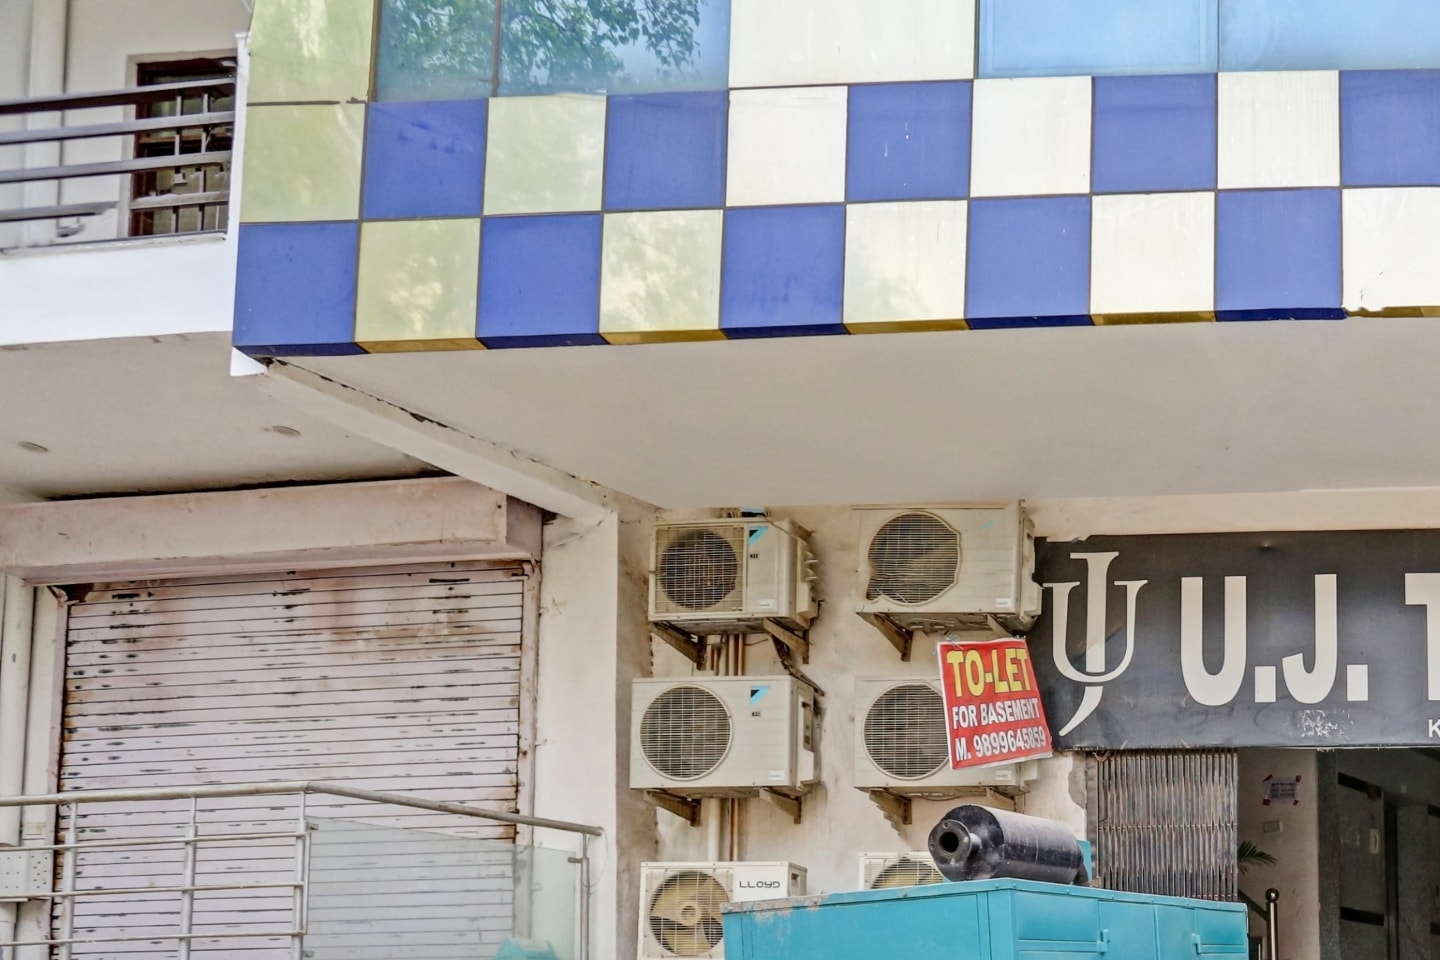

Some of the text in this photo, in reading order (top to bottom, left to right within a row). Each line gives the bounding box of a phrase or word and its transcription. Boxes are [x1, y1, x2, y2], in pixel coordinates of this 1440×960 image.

[1181, 573, 1369, 706] U.J.
[946, 648, 1031, 697] TO-LET
[952, 698, 1040, 729] FOR BASEMENT
[955, 726, 1046, 761] M. 9899645859
[739, 880, 781, 889] LLOYD
